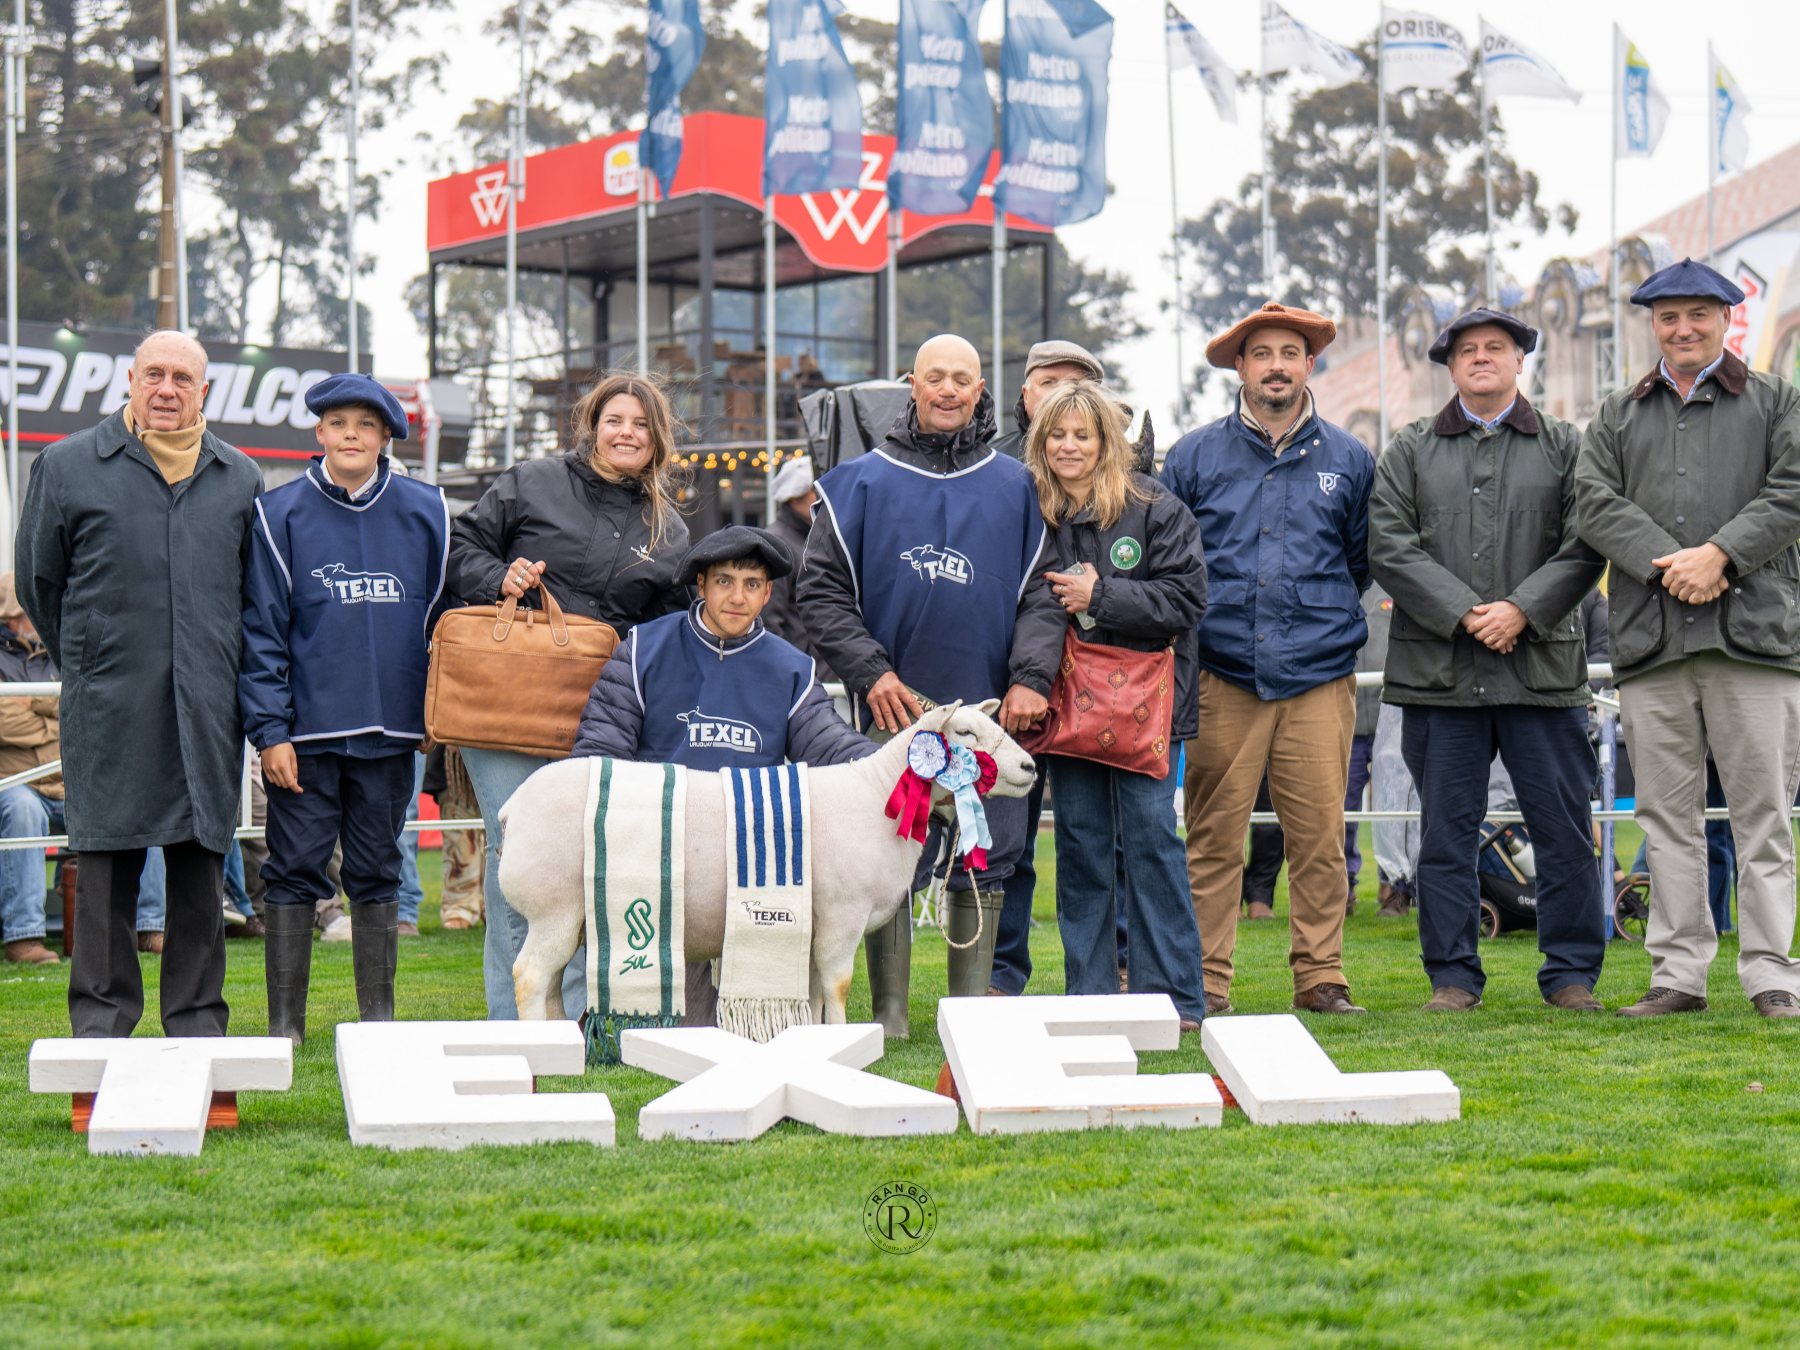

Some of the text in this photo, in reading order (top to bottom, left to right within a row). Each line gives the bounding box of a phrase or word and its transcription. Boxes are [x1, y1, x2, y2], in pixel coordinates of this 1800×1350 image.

[335, 577, 400, 599] TEXEL
[689, 722, 757, 748] TEXEL
[753, 910, 793, 923] TEXEL
[619, 954, 655, 976] SUL
[28, 993, 1461, 1155] TEXEL
